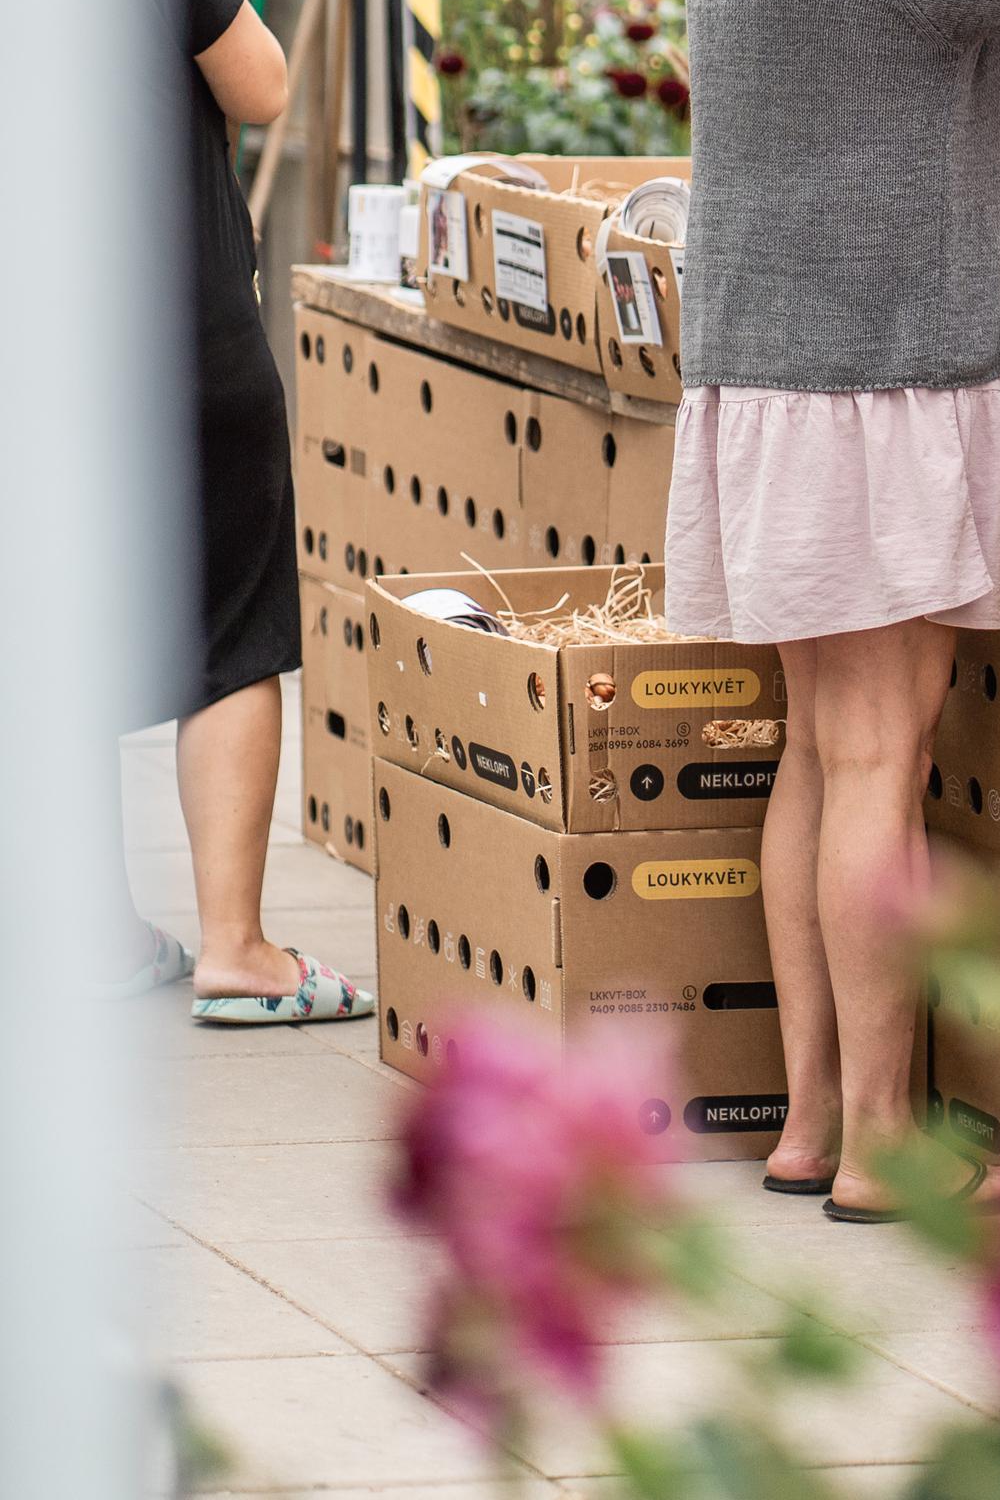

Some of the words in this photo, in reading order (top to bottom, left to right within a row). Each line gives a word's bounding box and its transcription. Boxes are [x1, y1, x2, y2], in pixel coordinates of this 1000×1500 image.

[645, 677, 745, 695] LOUKYKVĚT
[588, 726, 640, 738] LKKVT-BOX
[636, 740, 661, 749] 6084
[665, 739, 689, 748] 3699
[476, 754, 510, 778] NEKLOPIT
[648, 868, 747, 887] LOUKYKVĚT
[590, 990, 646, 1000] LKKVT-BOX
[590, 1005, 615, 1013] 9409
[618, 1004, 643, 1012] 9085
[646, 1003, 669, 1012] 2310
[671, 1002, 696, 1011] 7486
[707, 1106, 787, 1121] NEKLOPIT
[957, 1112, 994, 1140] NEKLOPIT
